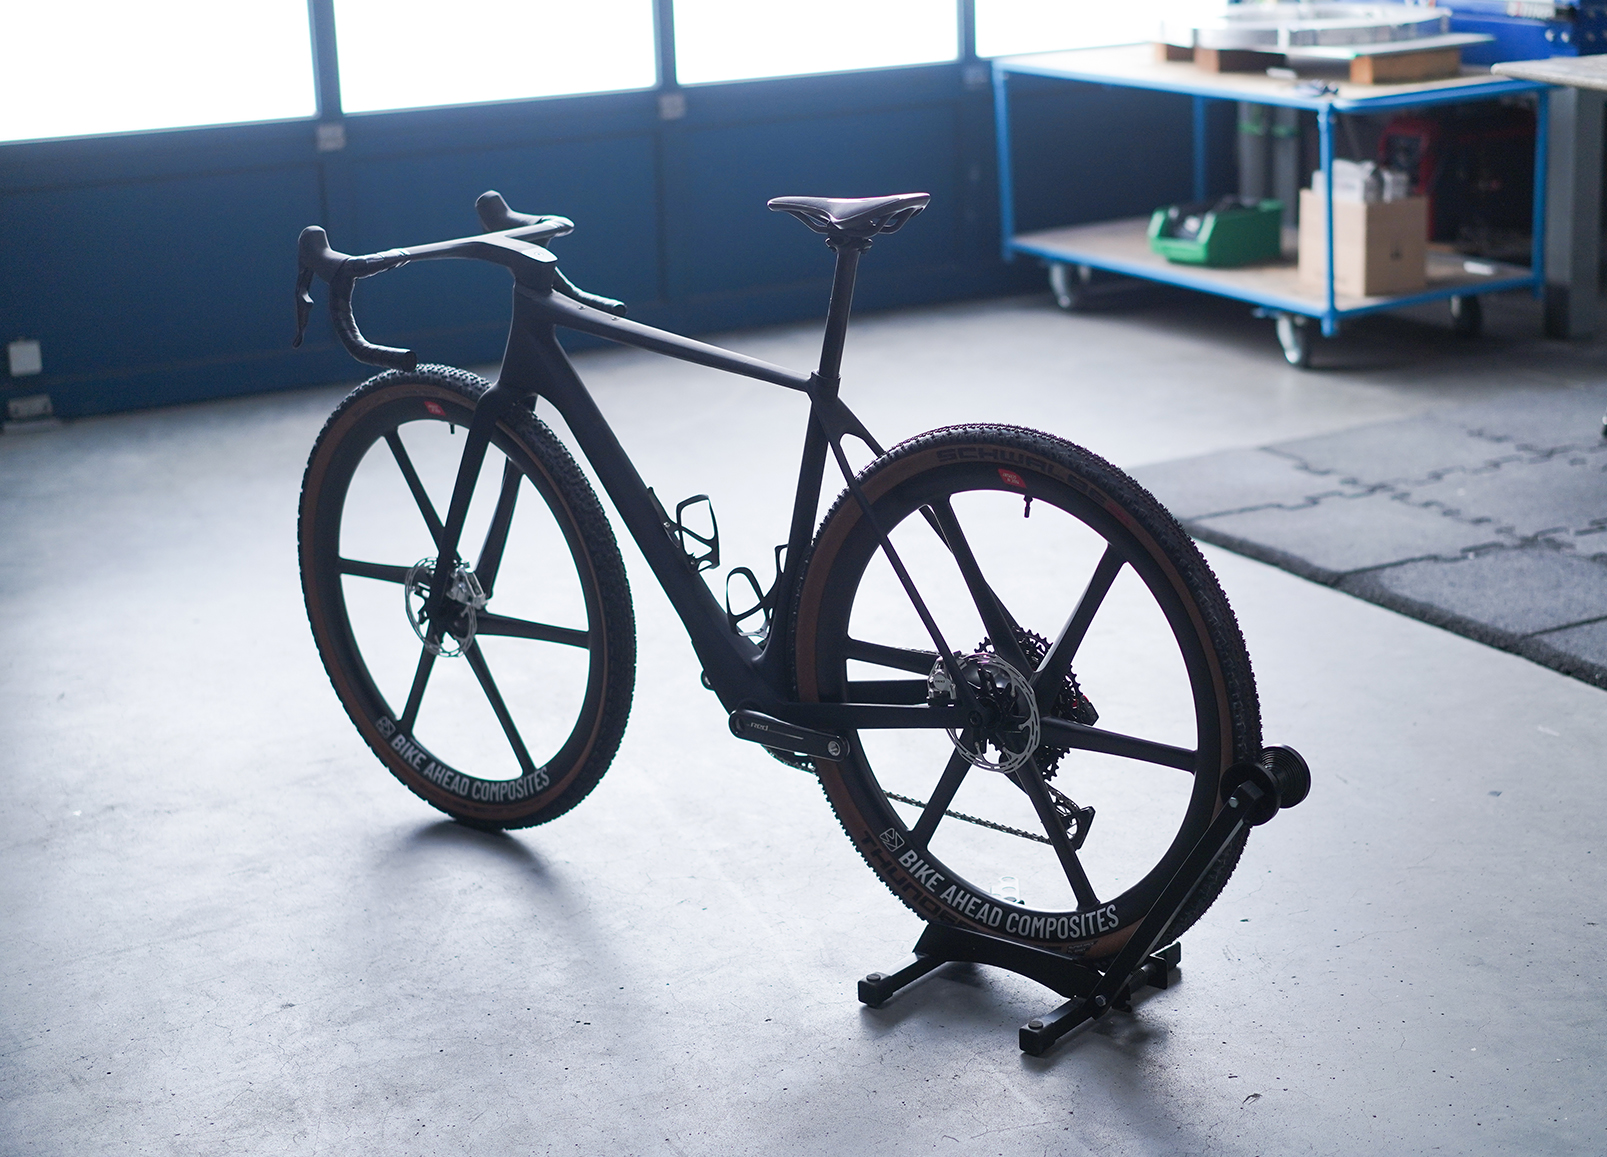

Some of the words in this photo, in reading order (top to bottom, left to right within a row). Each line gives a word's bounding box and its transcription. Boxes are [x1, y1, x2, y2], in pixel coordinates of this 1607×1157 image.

[936, 447, 1107, 506] SCHWALBE
[391, 733, 428, 771] BIKE
[423, 762, 470, 797] AHEAD
[471, 766, 550, 801] COMPOSITES
[898, 849, 945, 893] BIKE
[939, 885, 1003, 928] AHEAD
[1005, 903, 1120, 940] COMPOSITES
